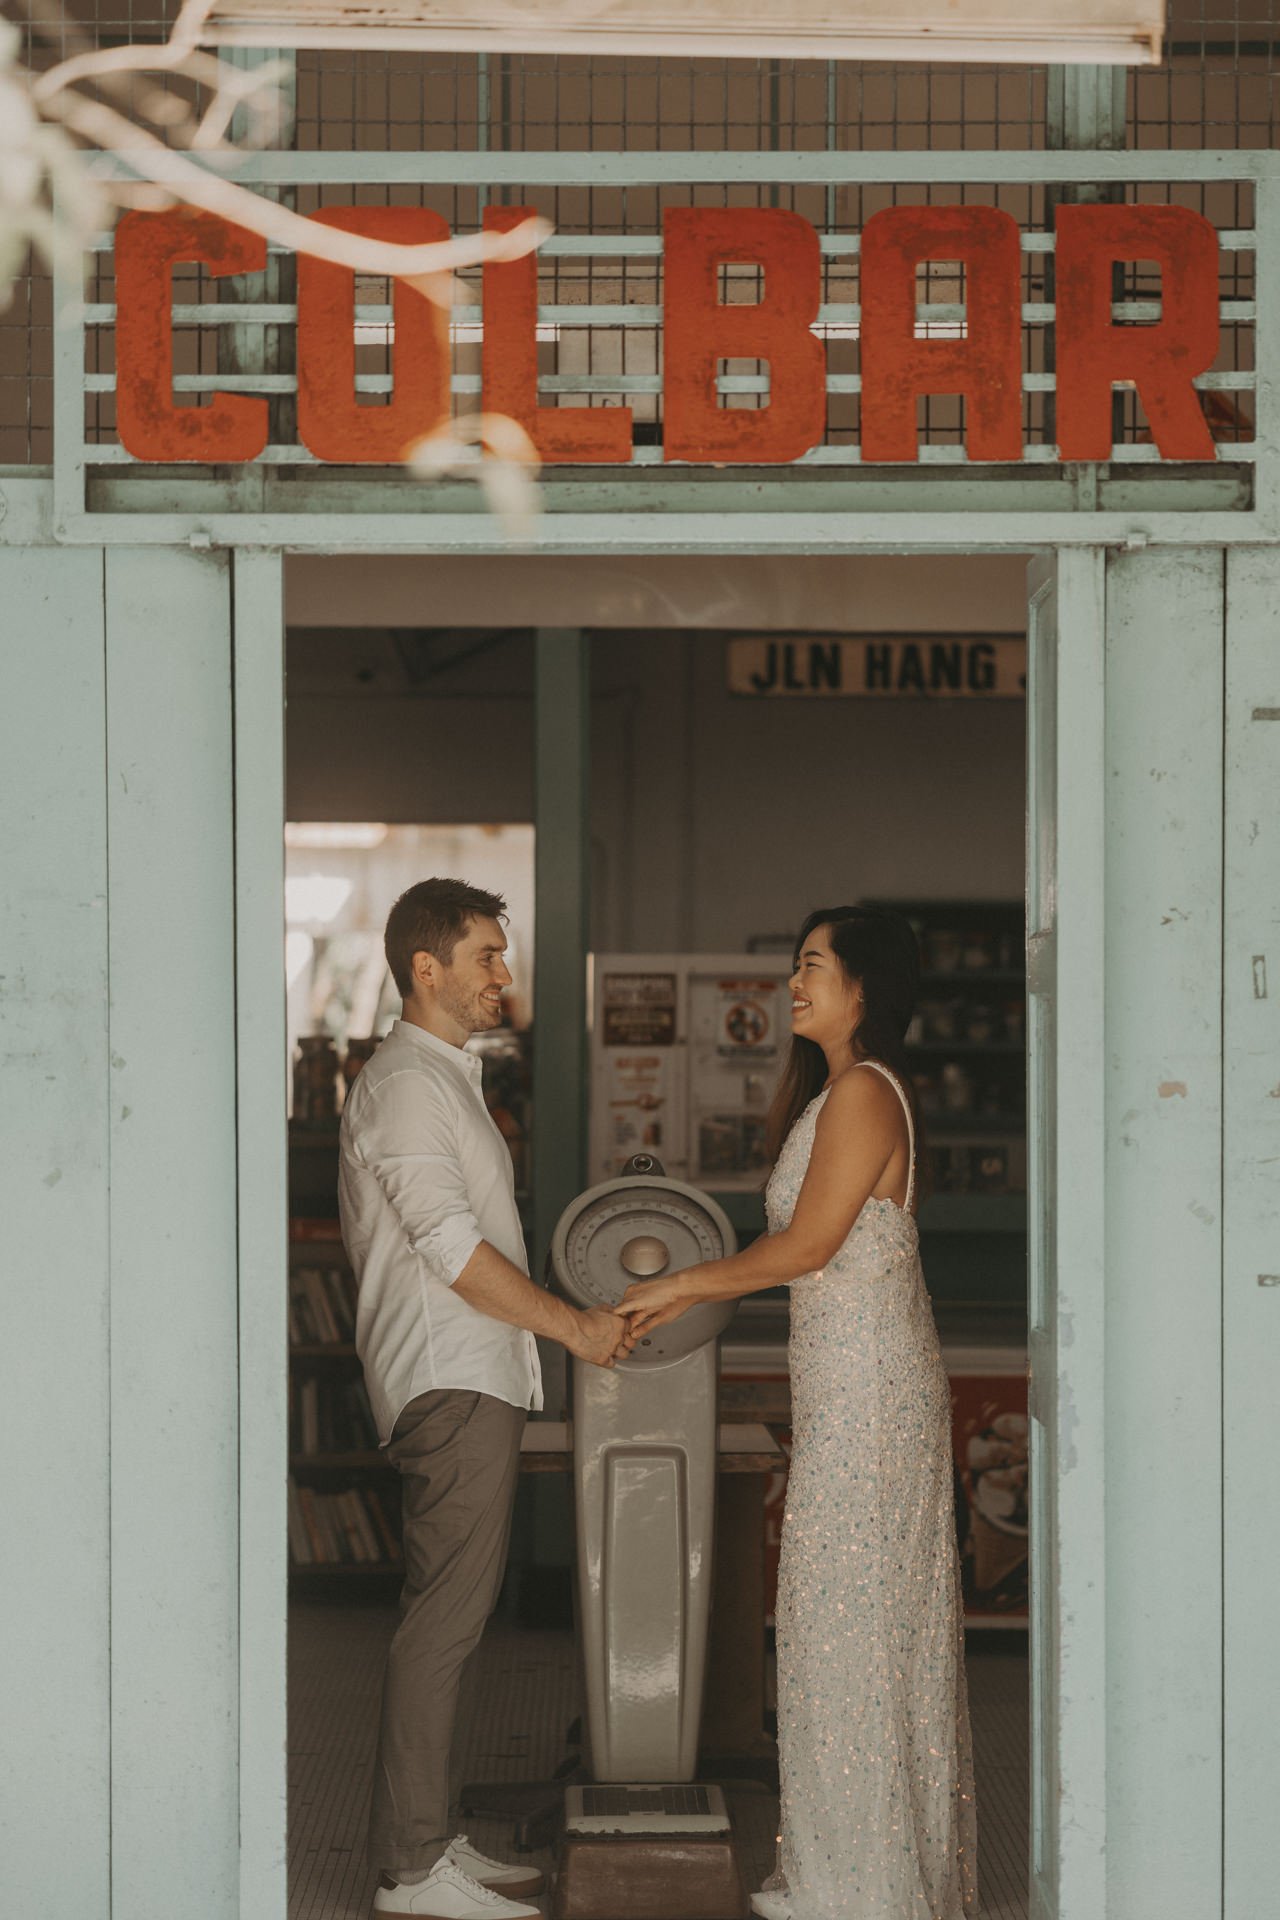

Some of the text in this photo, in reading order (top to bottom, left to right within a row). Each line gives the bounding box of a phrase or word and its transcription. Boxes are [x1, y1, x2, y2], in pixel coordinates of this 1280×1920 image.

[115, 203, 1220, 464] COLBAR
[751, 643, 841, 690] JLN
[864, 643, 996, 690] HANG
